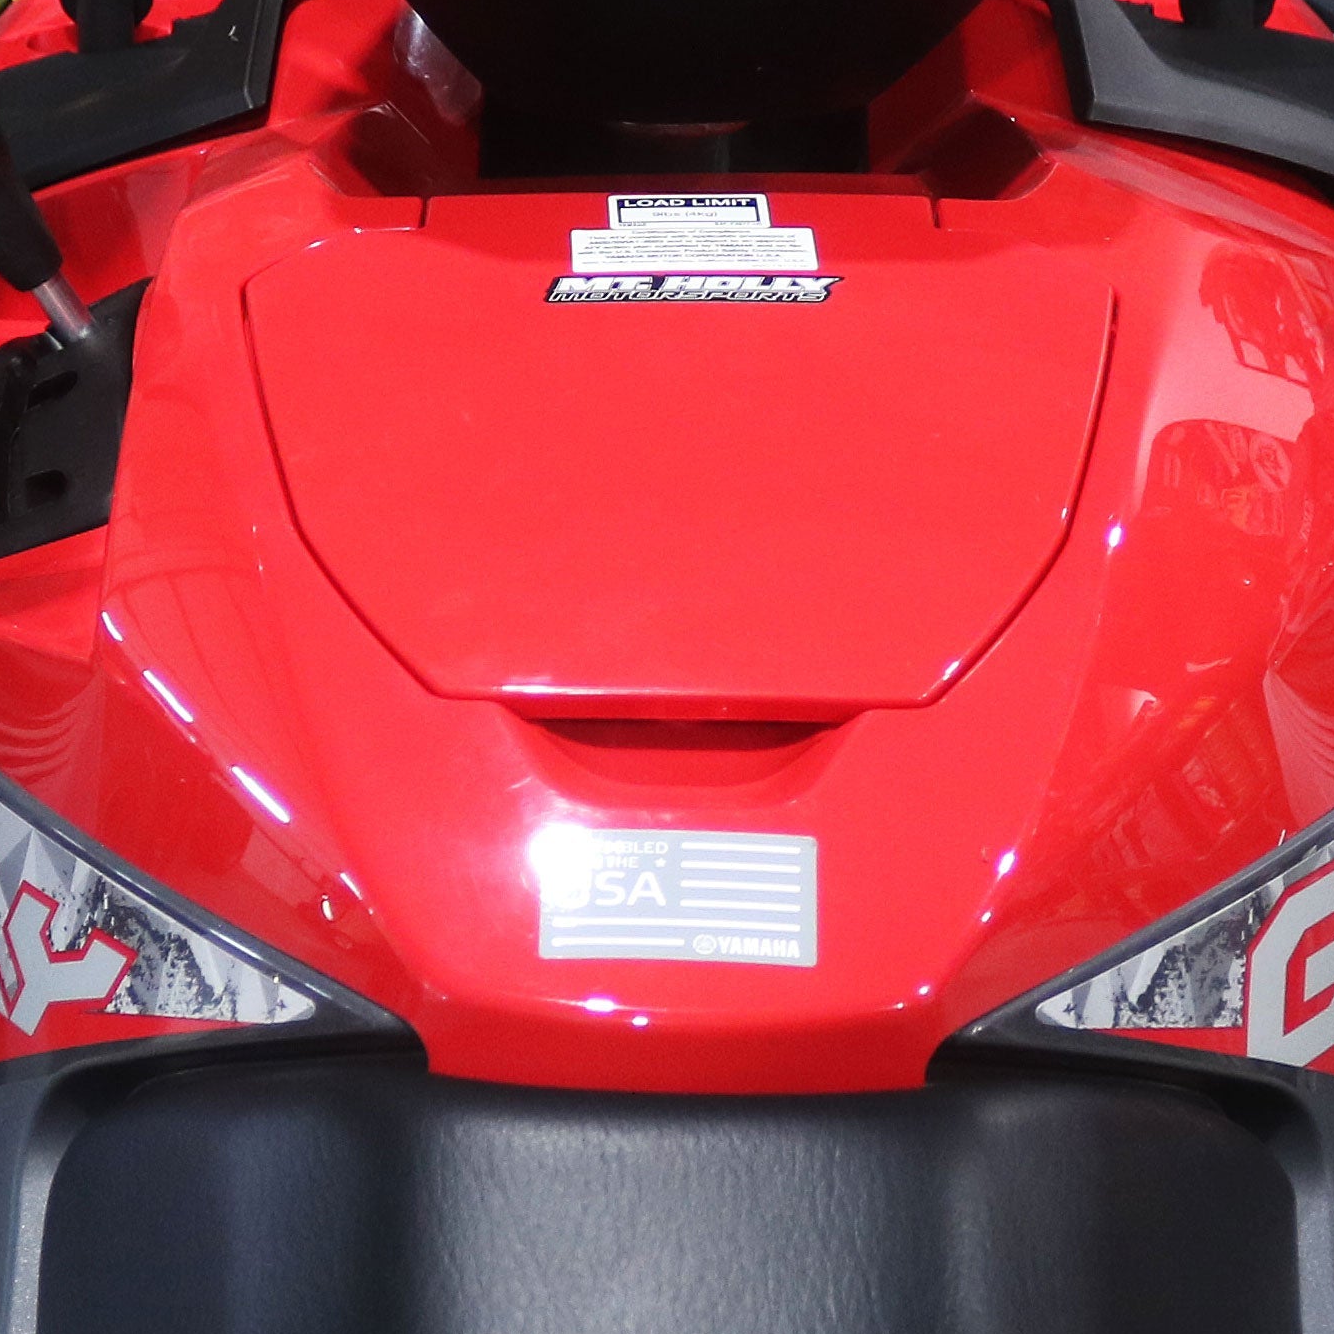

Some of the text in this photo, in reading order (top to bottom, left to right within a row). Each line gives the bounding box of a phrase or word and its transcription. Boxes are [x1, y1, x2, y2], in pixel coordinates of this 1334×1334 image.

[624, 198, 751, 207] LOAD LIMIT
[556, 276, 841, 293] MT. HOLLY
[548, 290, 828, 302] MOTORSPORTS
[717, 936, 800, 958] YAMAHA
